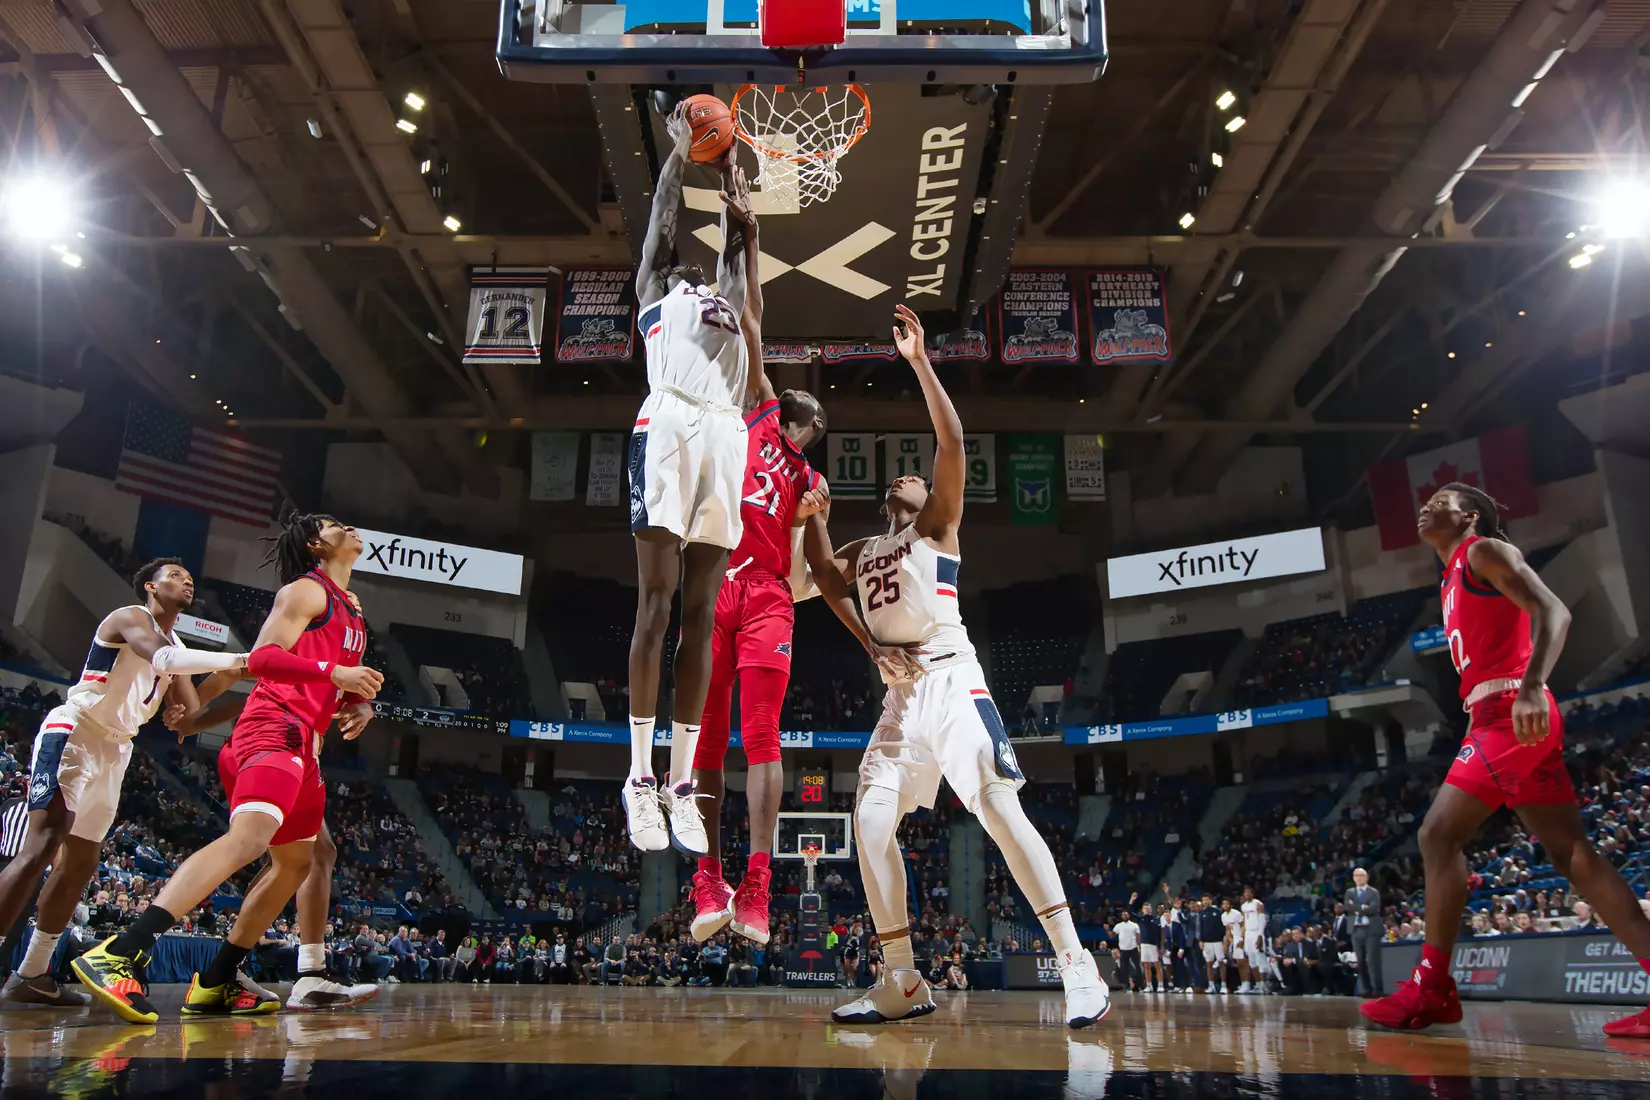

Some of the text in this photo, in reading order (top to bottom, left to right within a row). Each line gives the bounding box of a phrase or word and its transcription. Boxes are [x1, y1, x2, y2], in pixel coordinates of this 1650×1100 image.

[905, 122, 967, 299] XL CENTER
[566, 271, 632, 282] 1999-2000
[1010, 273, 1067, 282] 2003-2004
[571, 282, 625, 293] REGULAR
[1012, 282, 1063, 291] EASTERN
[1091, 282, 1159, 290] NORTHEAST
[573, 293, 620, 304] SEASON
[1004, 292, 1070, 301] CONFERENCE
[1100, 290, 1152, 299] DIVISION
[1004, 302, 1070, 311] CHAMPIONS
[1094, 298, 1161, 307] CHAMPIONS
[562, 305, 630, 316] CHAMPIONS
[479, 306, 531, 339] 12
[837, 456, 867, 480] 10
[742, 471, 781, 517] 21
[366, 538, 468, 581] xfinity
[858, 542, 912, 578] UCONN
[1158, 546, 1259, 586] xfinity
[866, 568, 900, 612] 25
[444, 612, 462, 622] 233
[195, 621, 222, 633] RICOH
[143, 675, 161, 705] 1
[1217, 709, 1248, 724] CBS
[1277, 708, 1304, 717] Company
[529, 721, 560, 733] CBS
[1087, 725, 1119, 737] CBS
[1147, 725, 1173, 733] Company
[779, 731, 810, 741] CBS
[837, 736, 861, 744] Company
[802, 776, 824, 785] 19:08
[801, 785, 822, 802] 20
[1585, 942, 1610, 956] GET
[1456, 946, 1511, 967] UCONN
[785, 971, 836, 981] TRAVELERS
